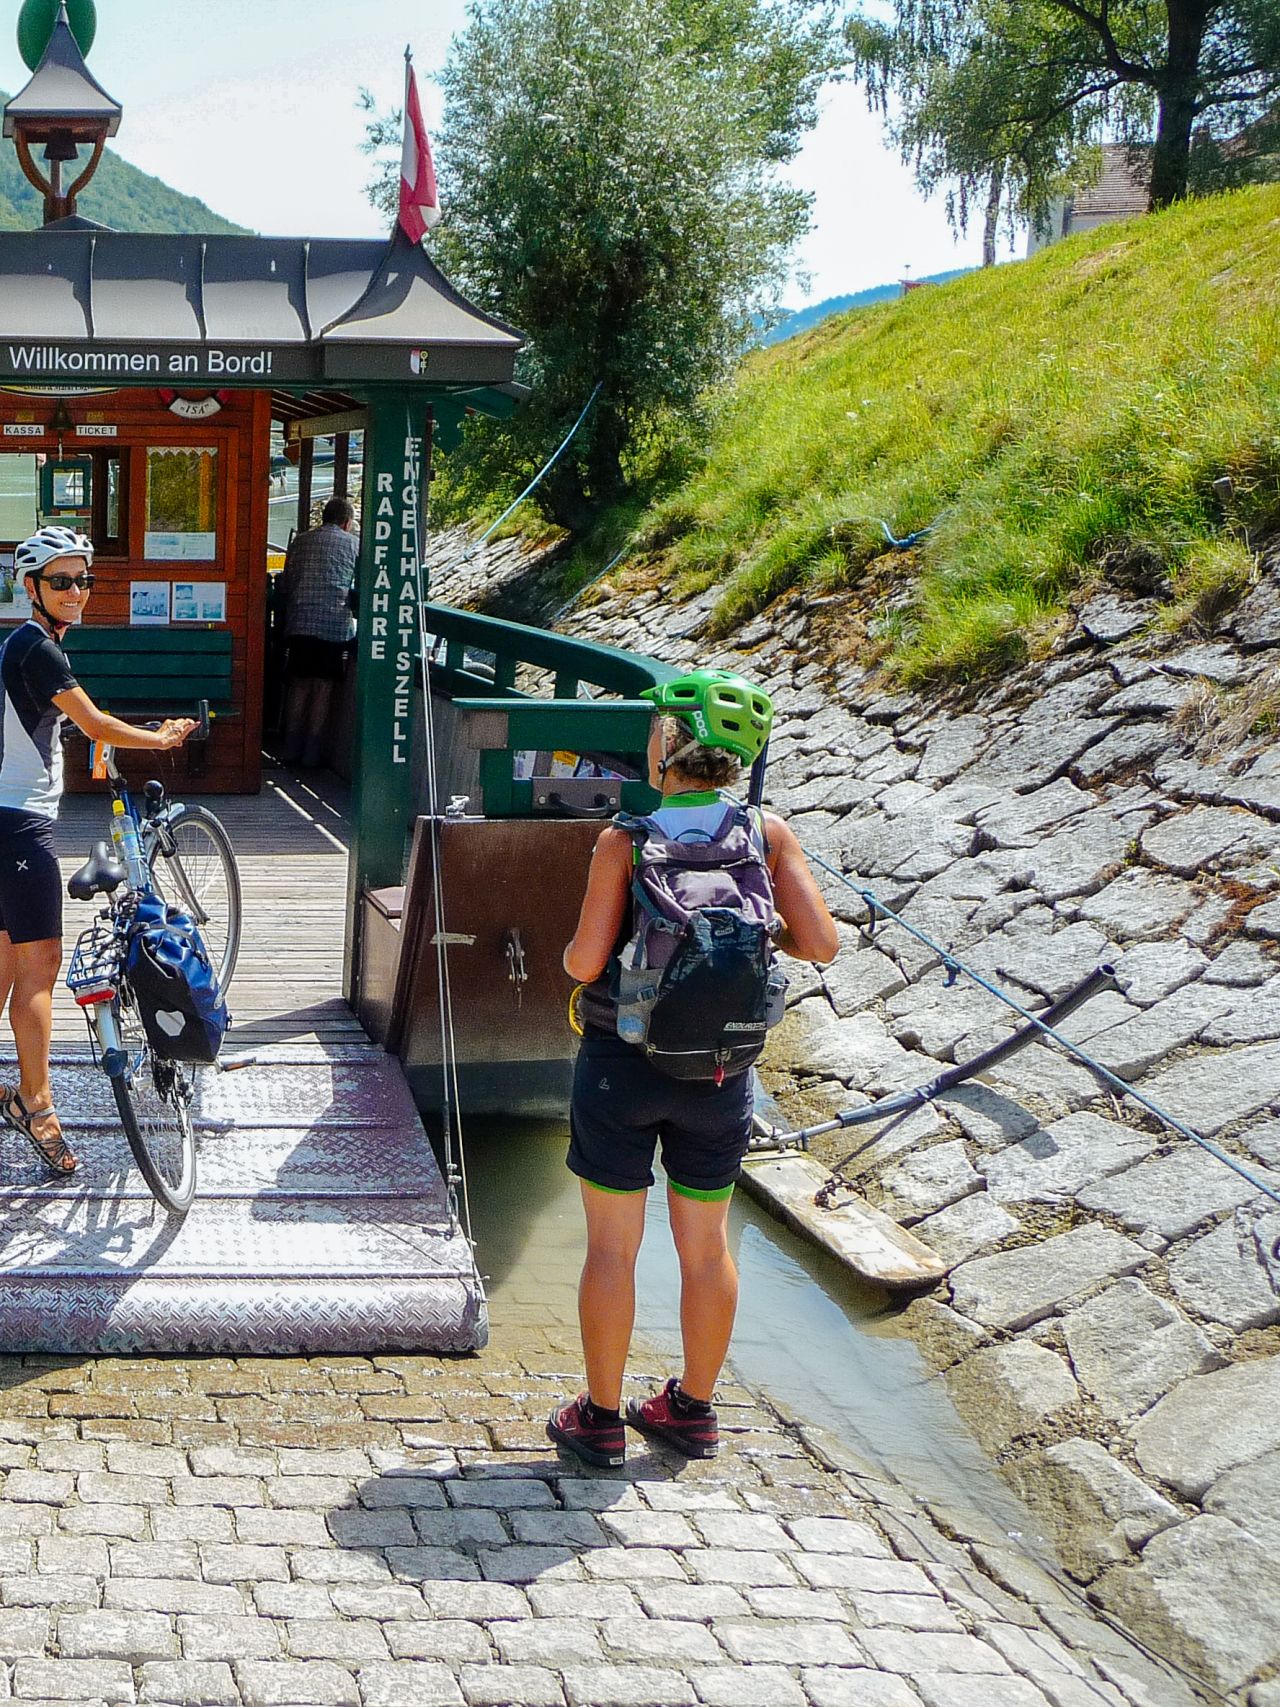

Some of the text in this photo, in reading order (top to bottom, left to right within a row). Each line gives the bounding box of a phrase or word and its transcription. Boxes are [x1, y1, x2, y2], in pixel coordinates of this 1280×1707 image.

[9, 347, 272, 373] Willkommen an Bord!
[5, 426, 41, 435] KASSA
[77, 426, 115, 435] TICKET
[371, 472, 395, 660] RADFÄHRE
[393, 437, 422, 763] ENGELHARTSZELL
